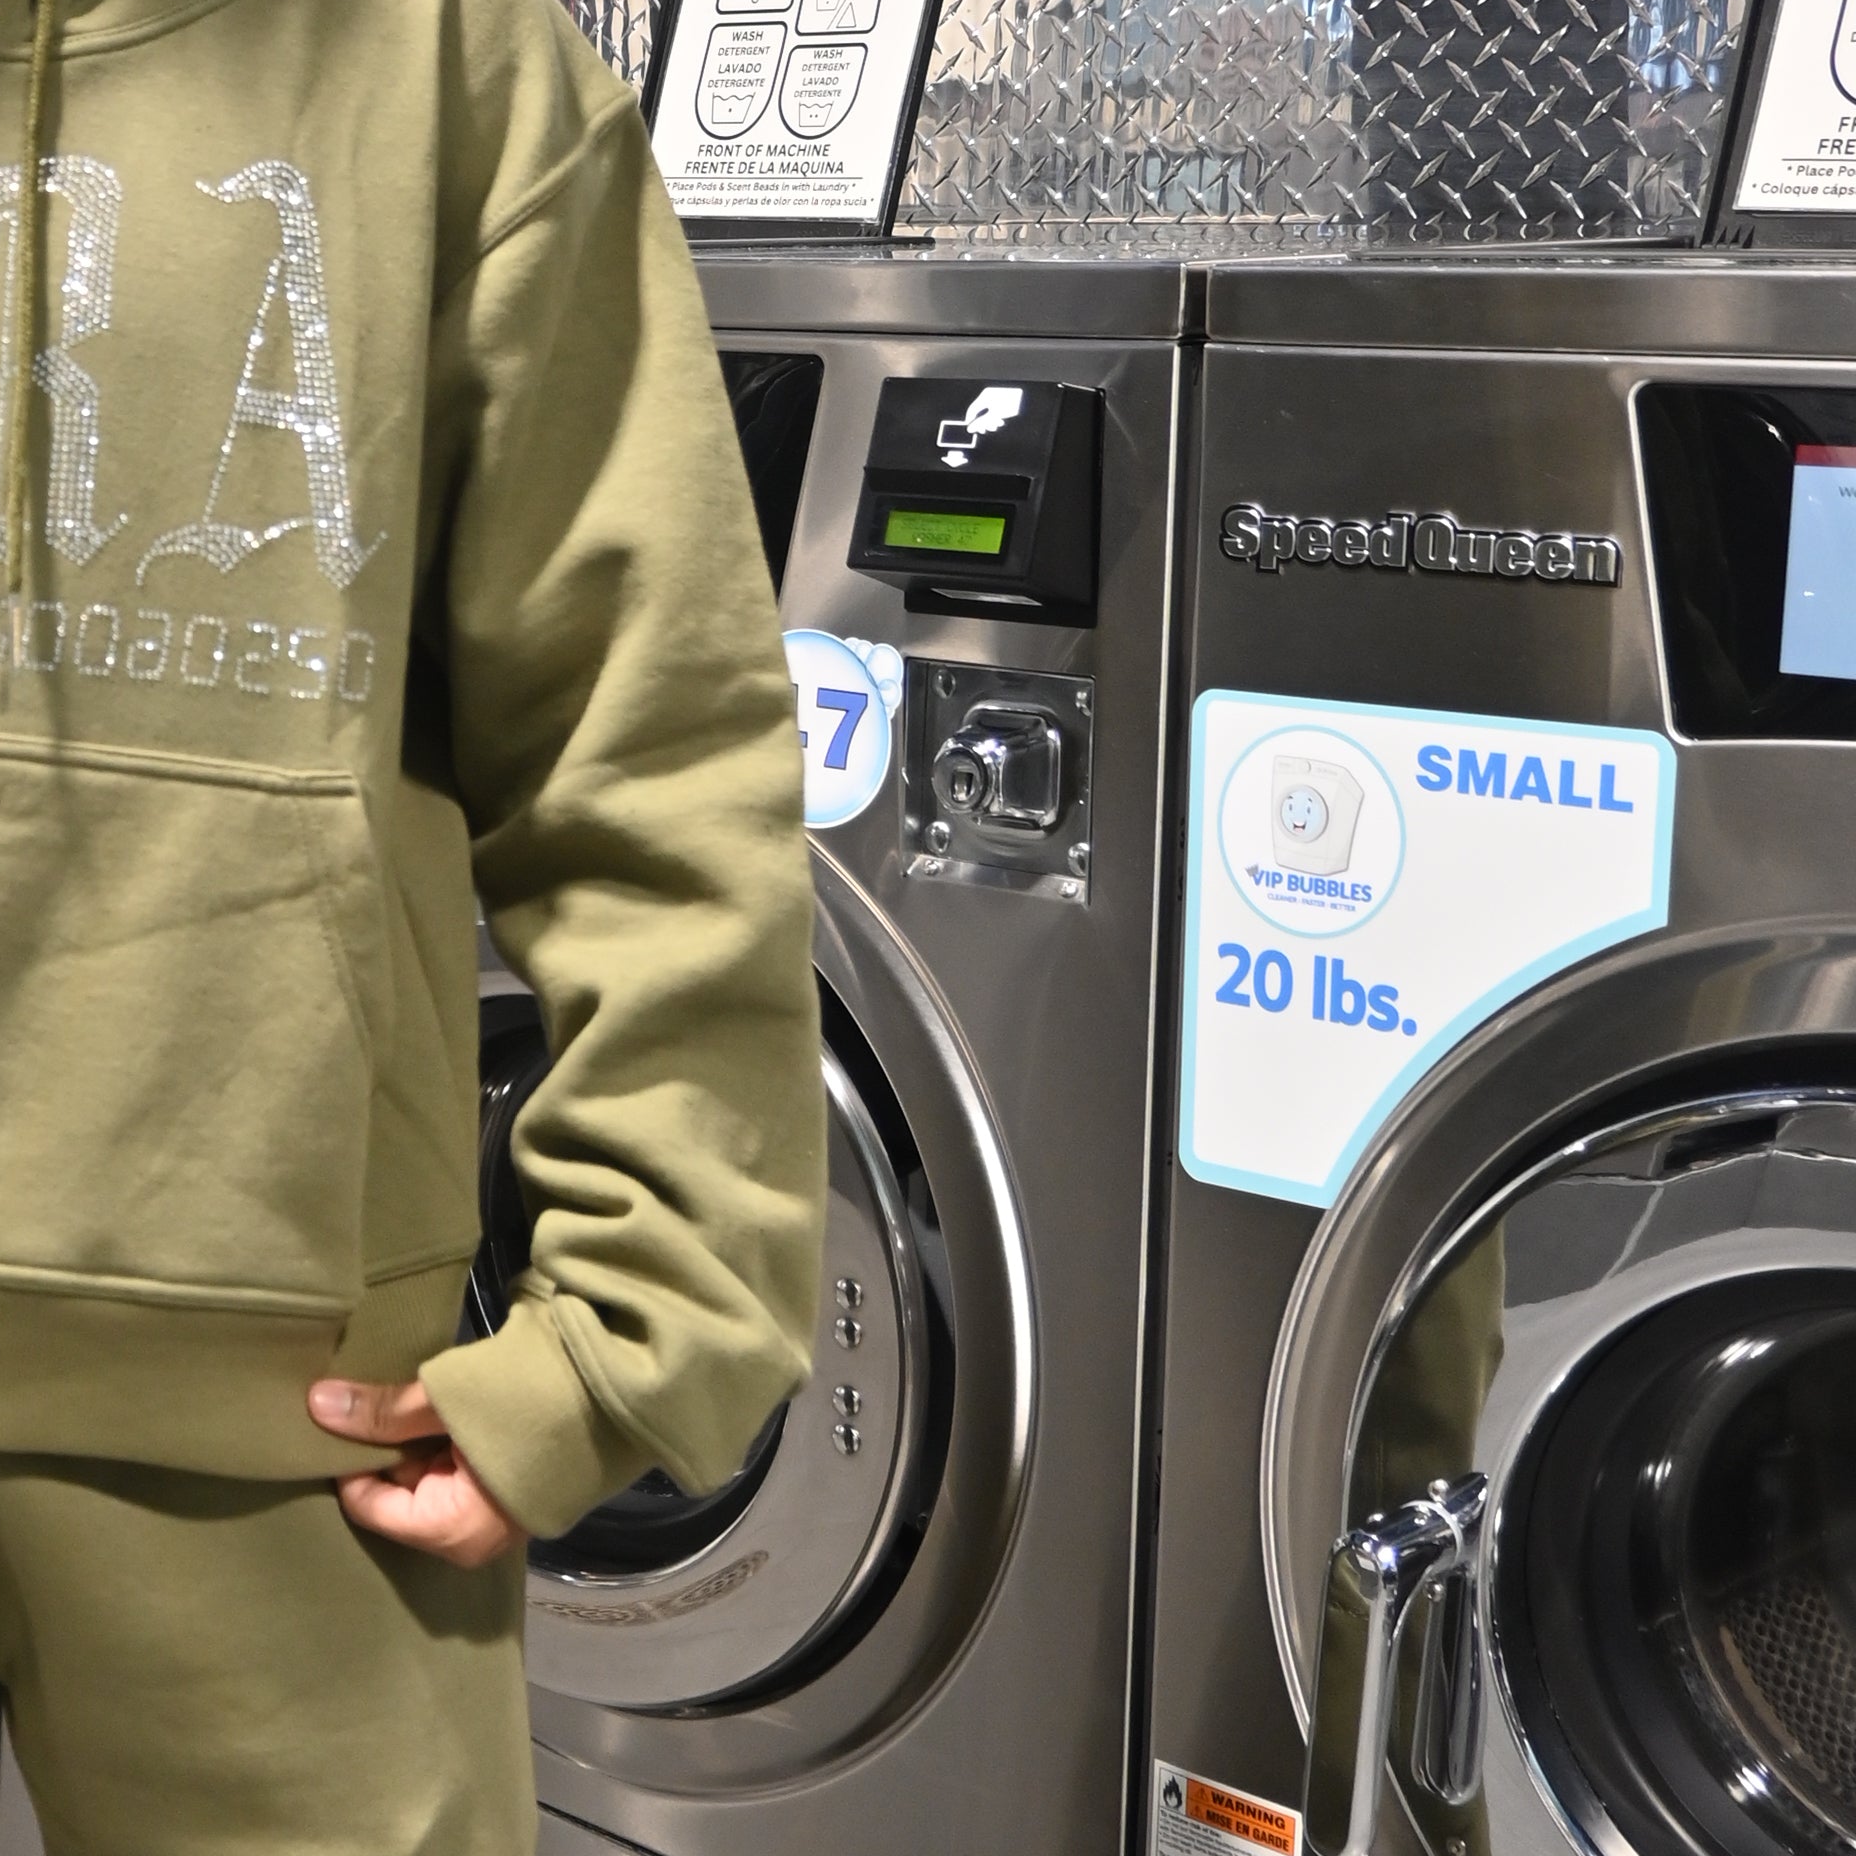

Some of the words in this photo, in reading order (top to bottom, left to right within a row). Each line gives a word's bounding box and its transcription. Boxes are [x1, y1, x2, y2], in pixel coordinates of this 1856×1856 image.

[732, 31, 764, 42] WASH
[717, 46, 771, 56] DETERGENT
[813, 49, 844, 59] WASH
[717, 62, 762, 74] LAVADO
[802, 62, 851, 72] DETERGENT
[707, 78, 766, 88] DETERGENTE
[802, 76, 840, 86] LAVADO
[794, 89, 842, 98] DETERGENTE
[697, 144, 742, 157] FRONT
[745, 144, 763, 157] OF
[765, 143, 831, 157] MACHINE
[1817, 138, 1856, 155] FRE
[684, 161, 735, 174] FRENTE
[737, 161, 755, 174] DE
[759, 161, 774, 174] LA
[778, 161, 844, 177] MAQUINA
[1796, 164, 1834, 177] Place
[672, 182, 694, 191] Place
[696, 182, 717, 191] Pods
[727, 182, 751, 191] Scent
[753, 182, 779, 191] Beads
[781, 182, 789, 191] in
[791, 182, 810, 191] with
[813, 182, 849, 194] Laundry
[1760, 182, 1819, 197] Coloque
[1822, 183, 1856, 198] cáps
[724, 198, 731, 207] y
[731, 197, 758, 207] perlas
[760, 197, 771, 205] de
[773, 197, 791, 205] olor
[811, 197, 819, 206] la
[821, 199, 841, 208] ropa
[844, 197, 867, 206] sucia
[1220, 503, 1411, 573] Speed
[1413, 510, 1623, 587] Queen
[1414, 743, 1634, 813] SMALL
[1251, 869, 1283, 889] VIP
[1287, 874, 1373, 903] BUBBLES
[1216, 942, 1294, 1012] 20
[1311, 955, 1417, 1037] lbs.
[1211, 1791, 1285, 1830] WARNING
[1206, 1809, 1233, 1830] MISE
[1236, 1820, 1249, 1836] EN
[1252, 1827, 1289, 1851] GARDE
